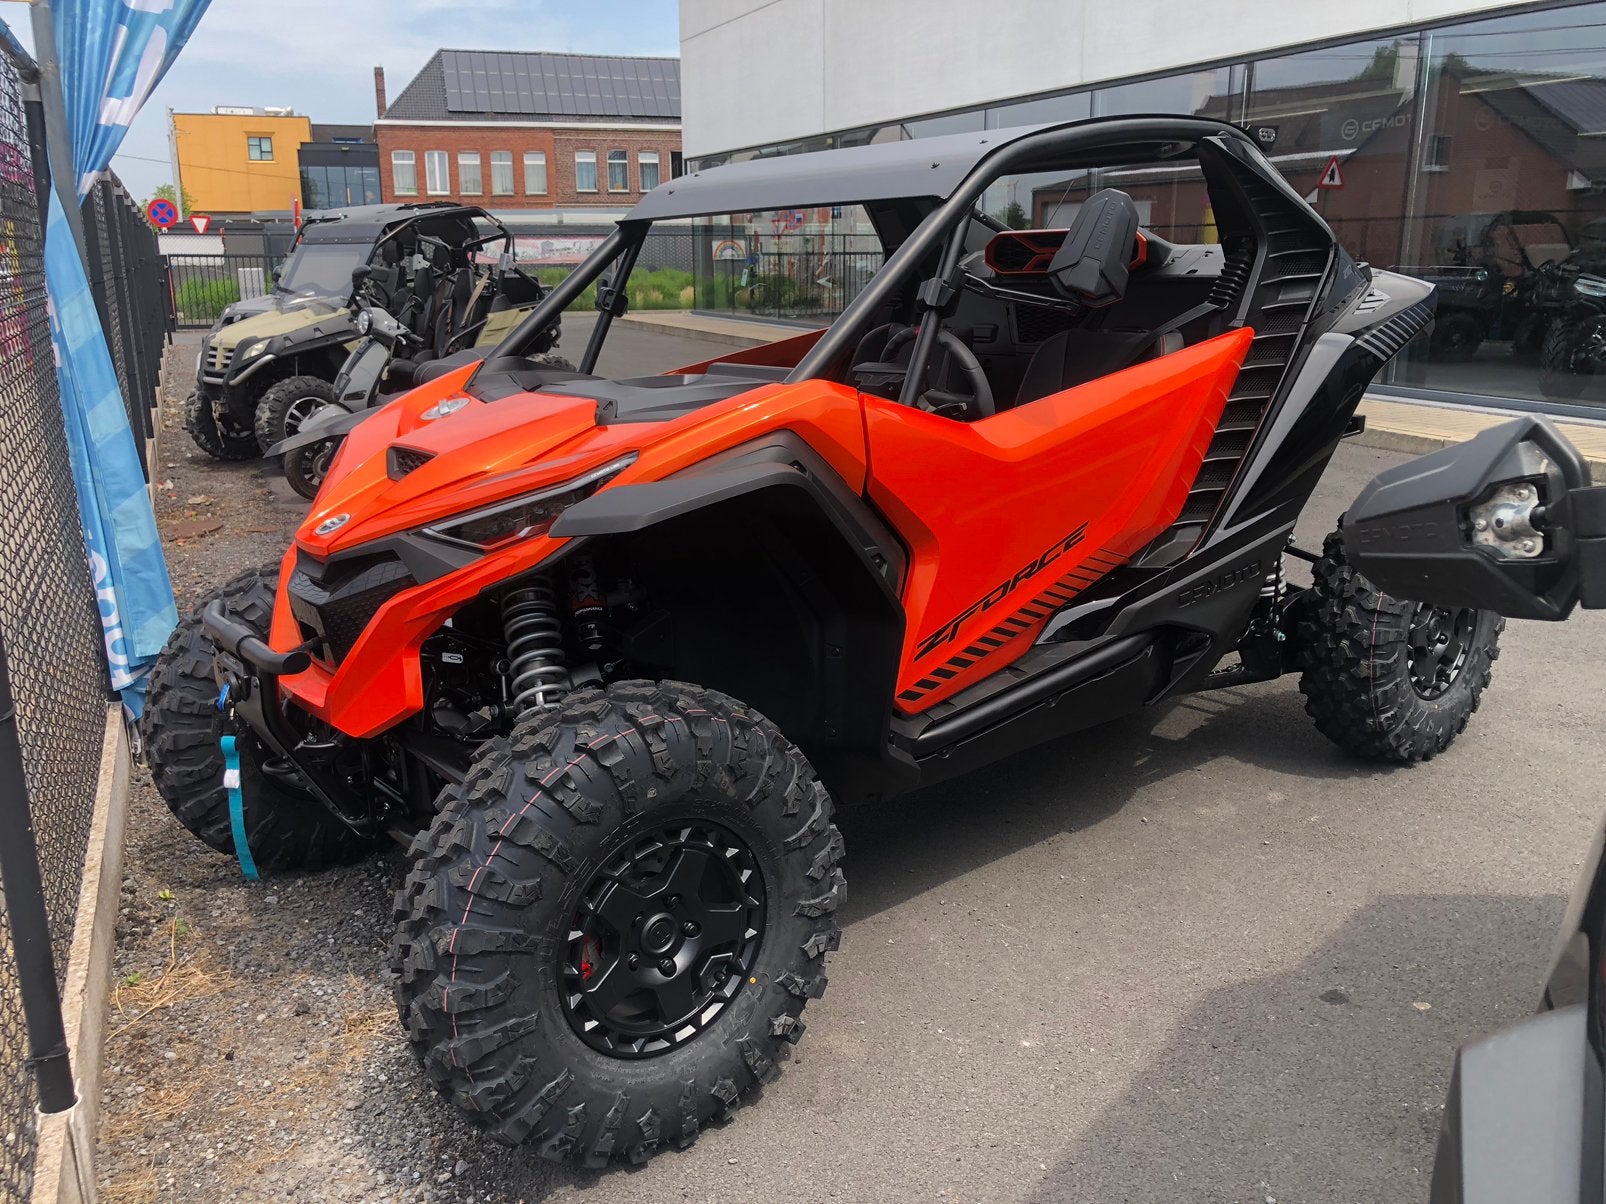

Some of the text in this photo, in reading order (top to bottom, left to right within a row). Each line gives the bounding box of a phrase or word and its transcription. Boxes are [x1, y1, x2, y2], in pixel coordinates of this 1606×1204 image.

[1361, 113, 1411, 132] CFMOT
[913, 521, 1089, 663] ZFORCE
[1178, 561, 1261, 609] CFMOTO
